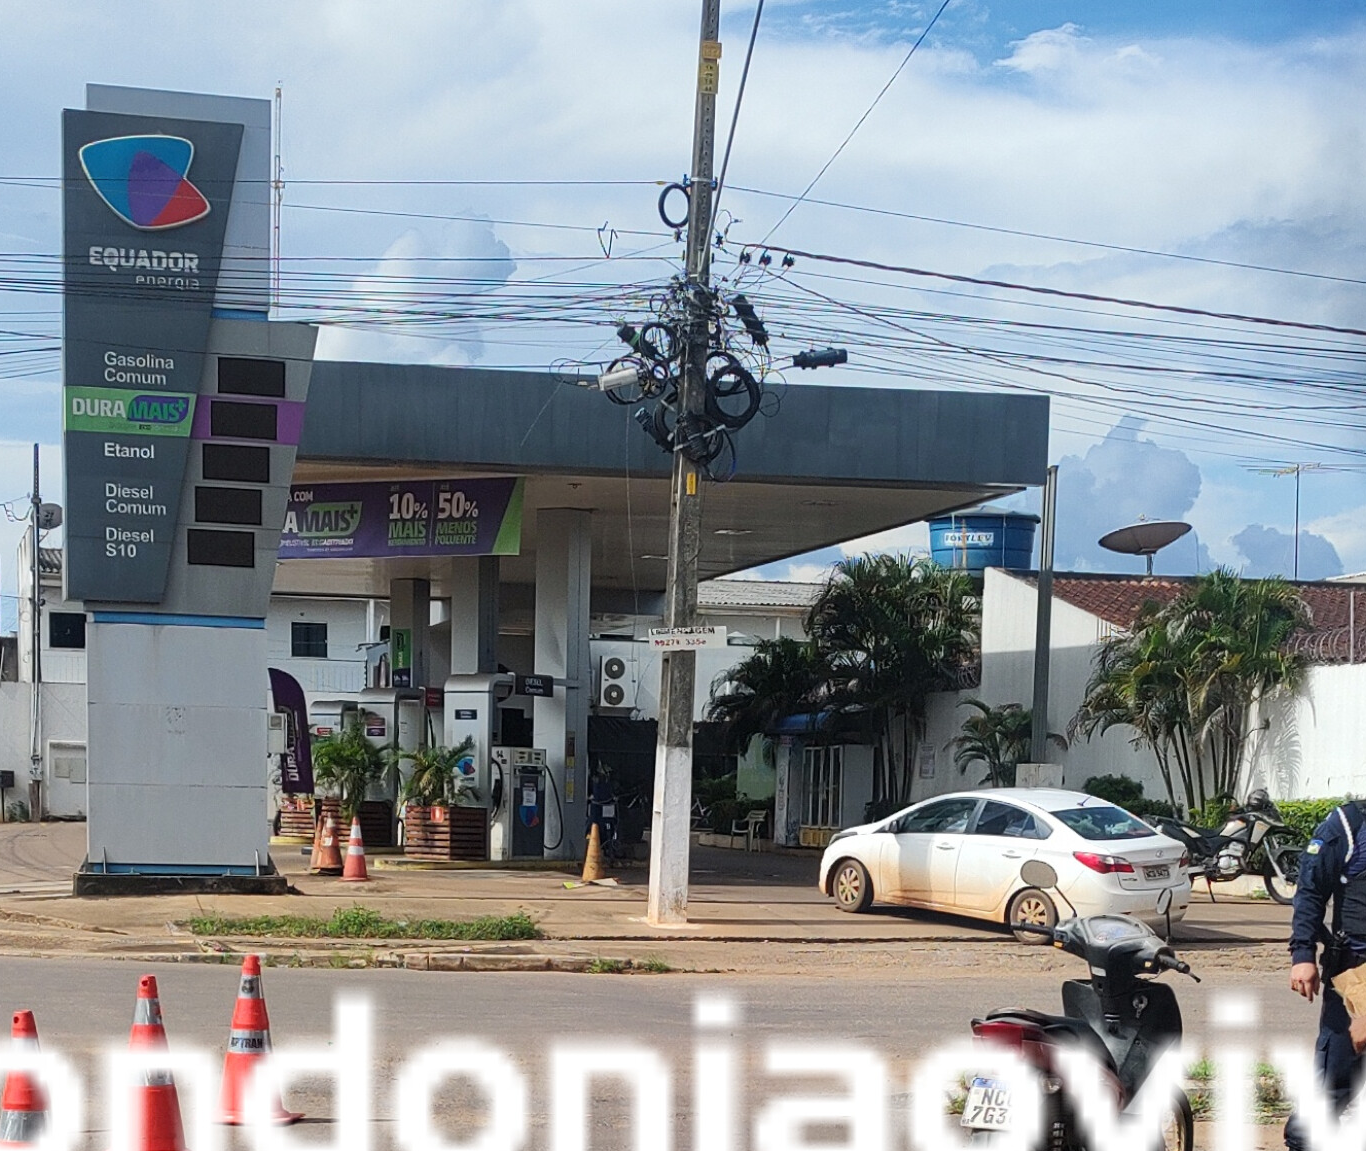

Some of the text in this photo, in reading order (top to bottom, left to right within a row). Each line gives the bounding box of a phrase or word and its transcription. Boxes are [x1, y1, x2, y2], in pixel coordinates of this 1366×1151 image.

[88, 246, 201, 274] EQUADOR
[135, 275, 200, 291] energia
[104, 351, 175, 370] Gasolina
[104, 367, 167, 386] Comum
[104, 442, 155, 459] Etanol
[105, 483, 153, 499] Diesel
[294, 490, 314, 502] COM
[105, 499, 167, 516] Comum
[388, 492, 428, 520] 10%
[436, 491, 479, 519] 50%
[105, 527, 154, 543] Diesel
[388, 521, 427, 539] MAIS
[435, 520, 478, 535] MENOS
[435, 534, 477, 546] POLUENTE
[105, 543, 137, 558] S10
[981, 1088, 1012, 1107] NC
